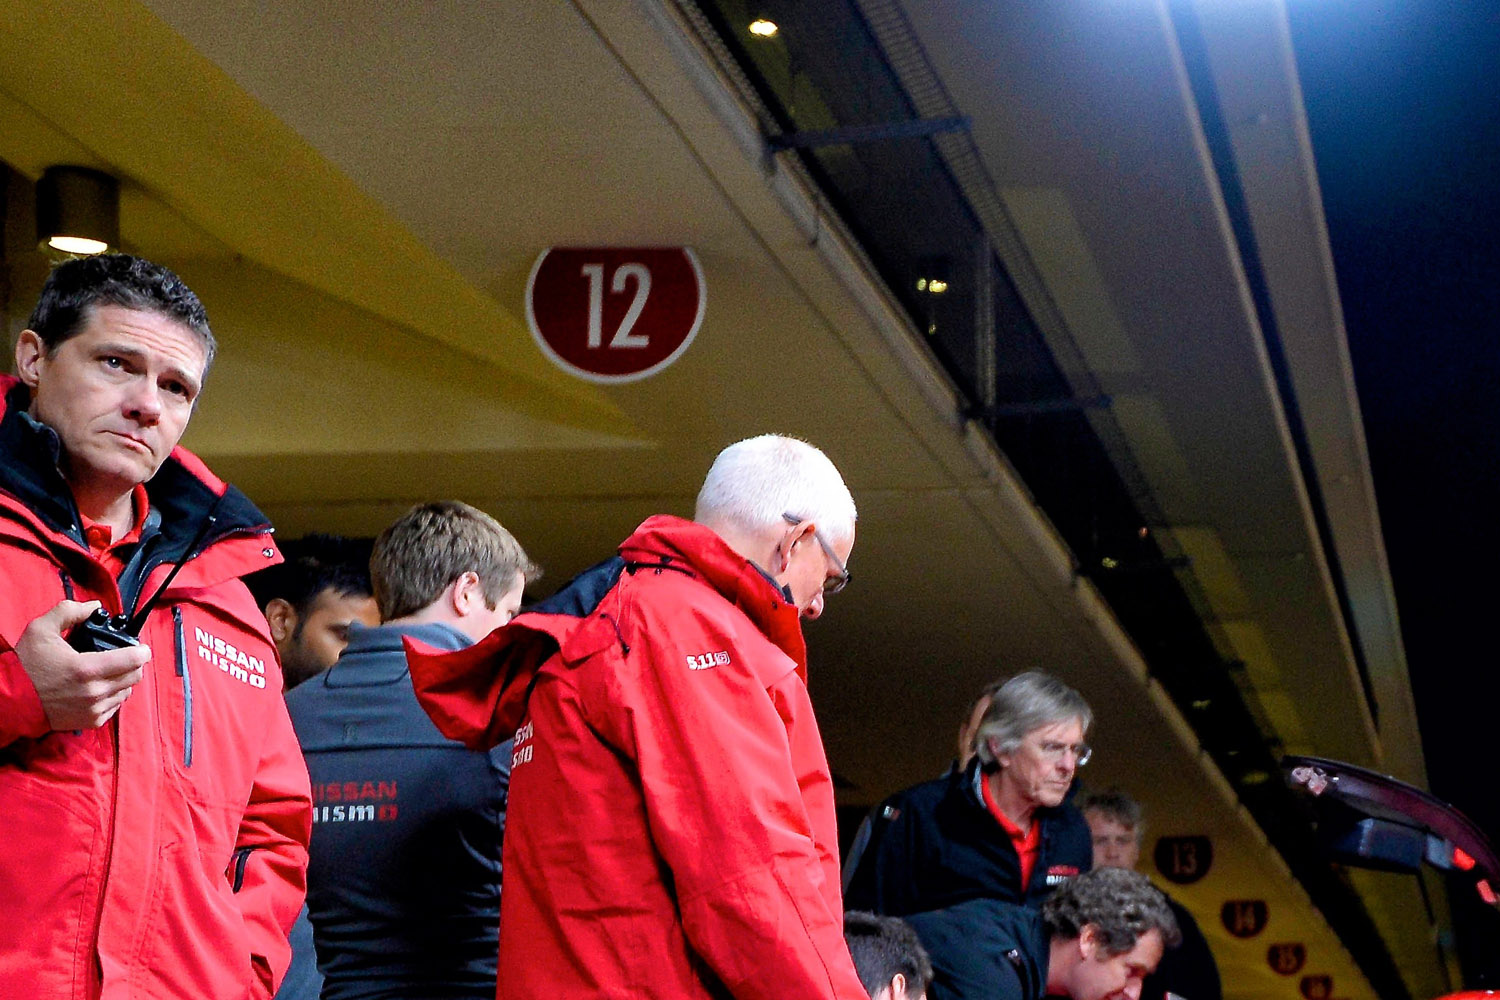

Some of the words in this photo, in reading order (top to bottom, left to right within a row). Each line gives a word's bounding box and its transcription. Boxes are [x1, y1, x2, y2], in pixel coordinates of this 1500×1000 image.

[581, 263, 652, 348] 12
[195, 626, 265, 674] NISSAN
[198, 645, 266, 689] nismo
[686, 652, 716, 670] 5.11
[1172, 842, 1198, 875] 13
